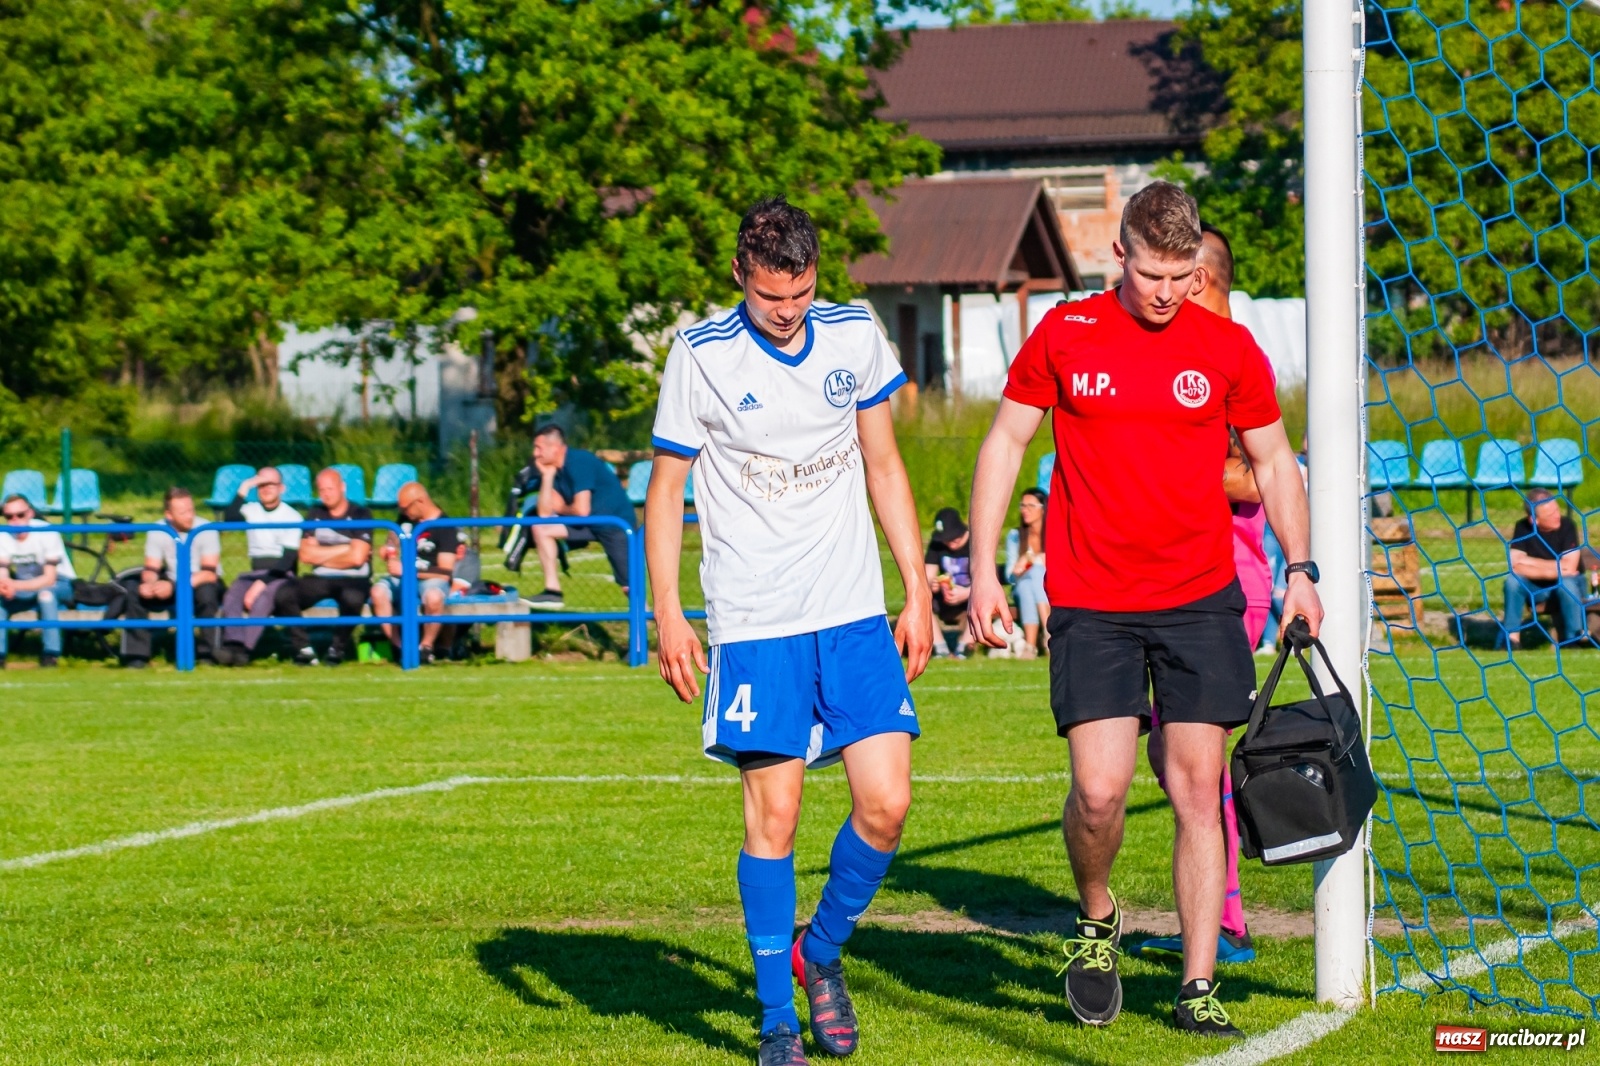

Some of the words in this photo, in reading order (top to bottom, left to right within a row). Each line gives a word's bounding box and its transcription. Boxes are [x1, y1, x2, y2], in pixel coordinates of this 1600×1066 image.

[828, 372, 853, 396] LKS
[837, 387, 847, 397] 07
[1072, 372, 1117, 397] M.P.
[1179, 373, 1206, 396] LKS
[1187, 387, 1199, 397] 07
[736, 403, 764, 412] adidas
[724, 683, 759, 733] 4
